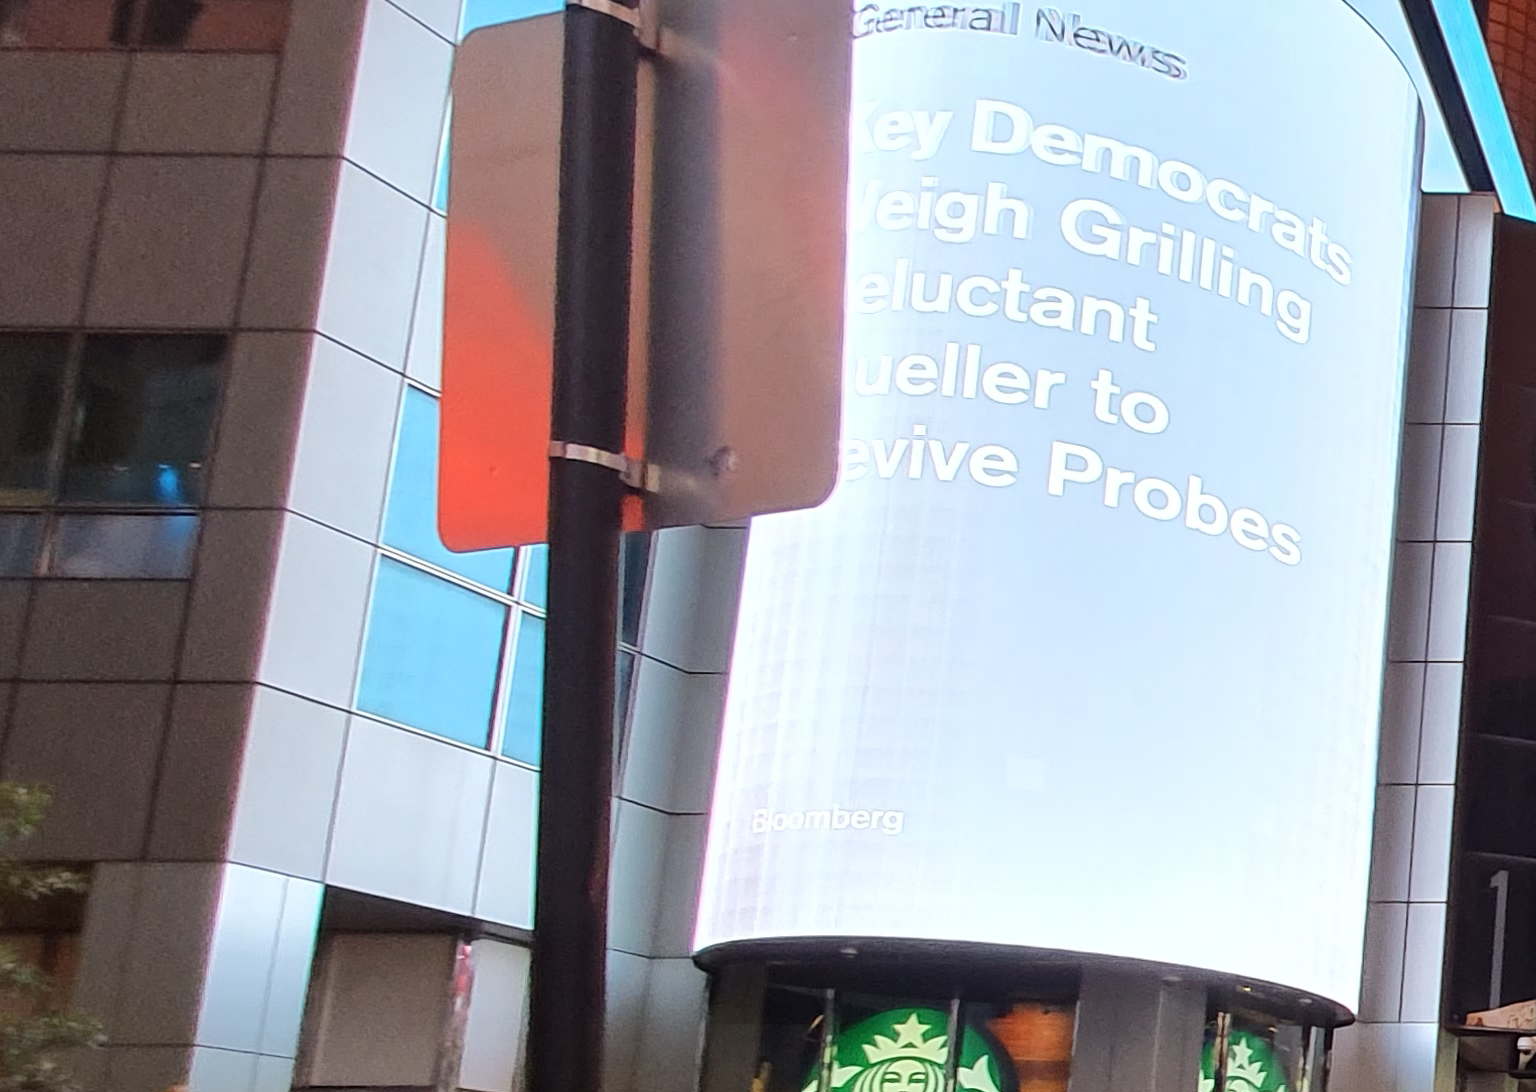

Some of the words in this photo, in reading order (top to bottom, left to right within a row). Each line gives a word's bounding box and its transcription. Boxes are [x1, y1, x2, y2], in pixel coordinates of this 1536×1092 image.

[852, 2, 1020, 39] General
[1035, 7, 1188, 81] News
[971, 98, 1353, 287] Democrats
[852, 257, 1160, 353] eluctant
[1060, 199, 1313, 345] Grilling
[854, 341, 1067, 411] ueller
[1090, 368, 1171, 435] to
[843, 424, 1020, 488] evive
[1047, 440, 1303, 567] Probes
[752, 806, 905, 837] Bloomberg
[1488, 869, 1510, 1009] 1
